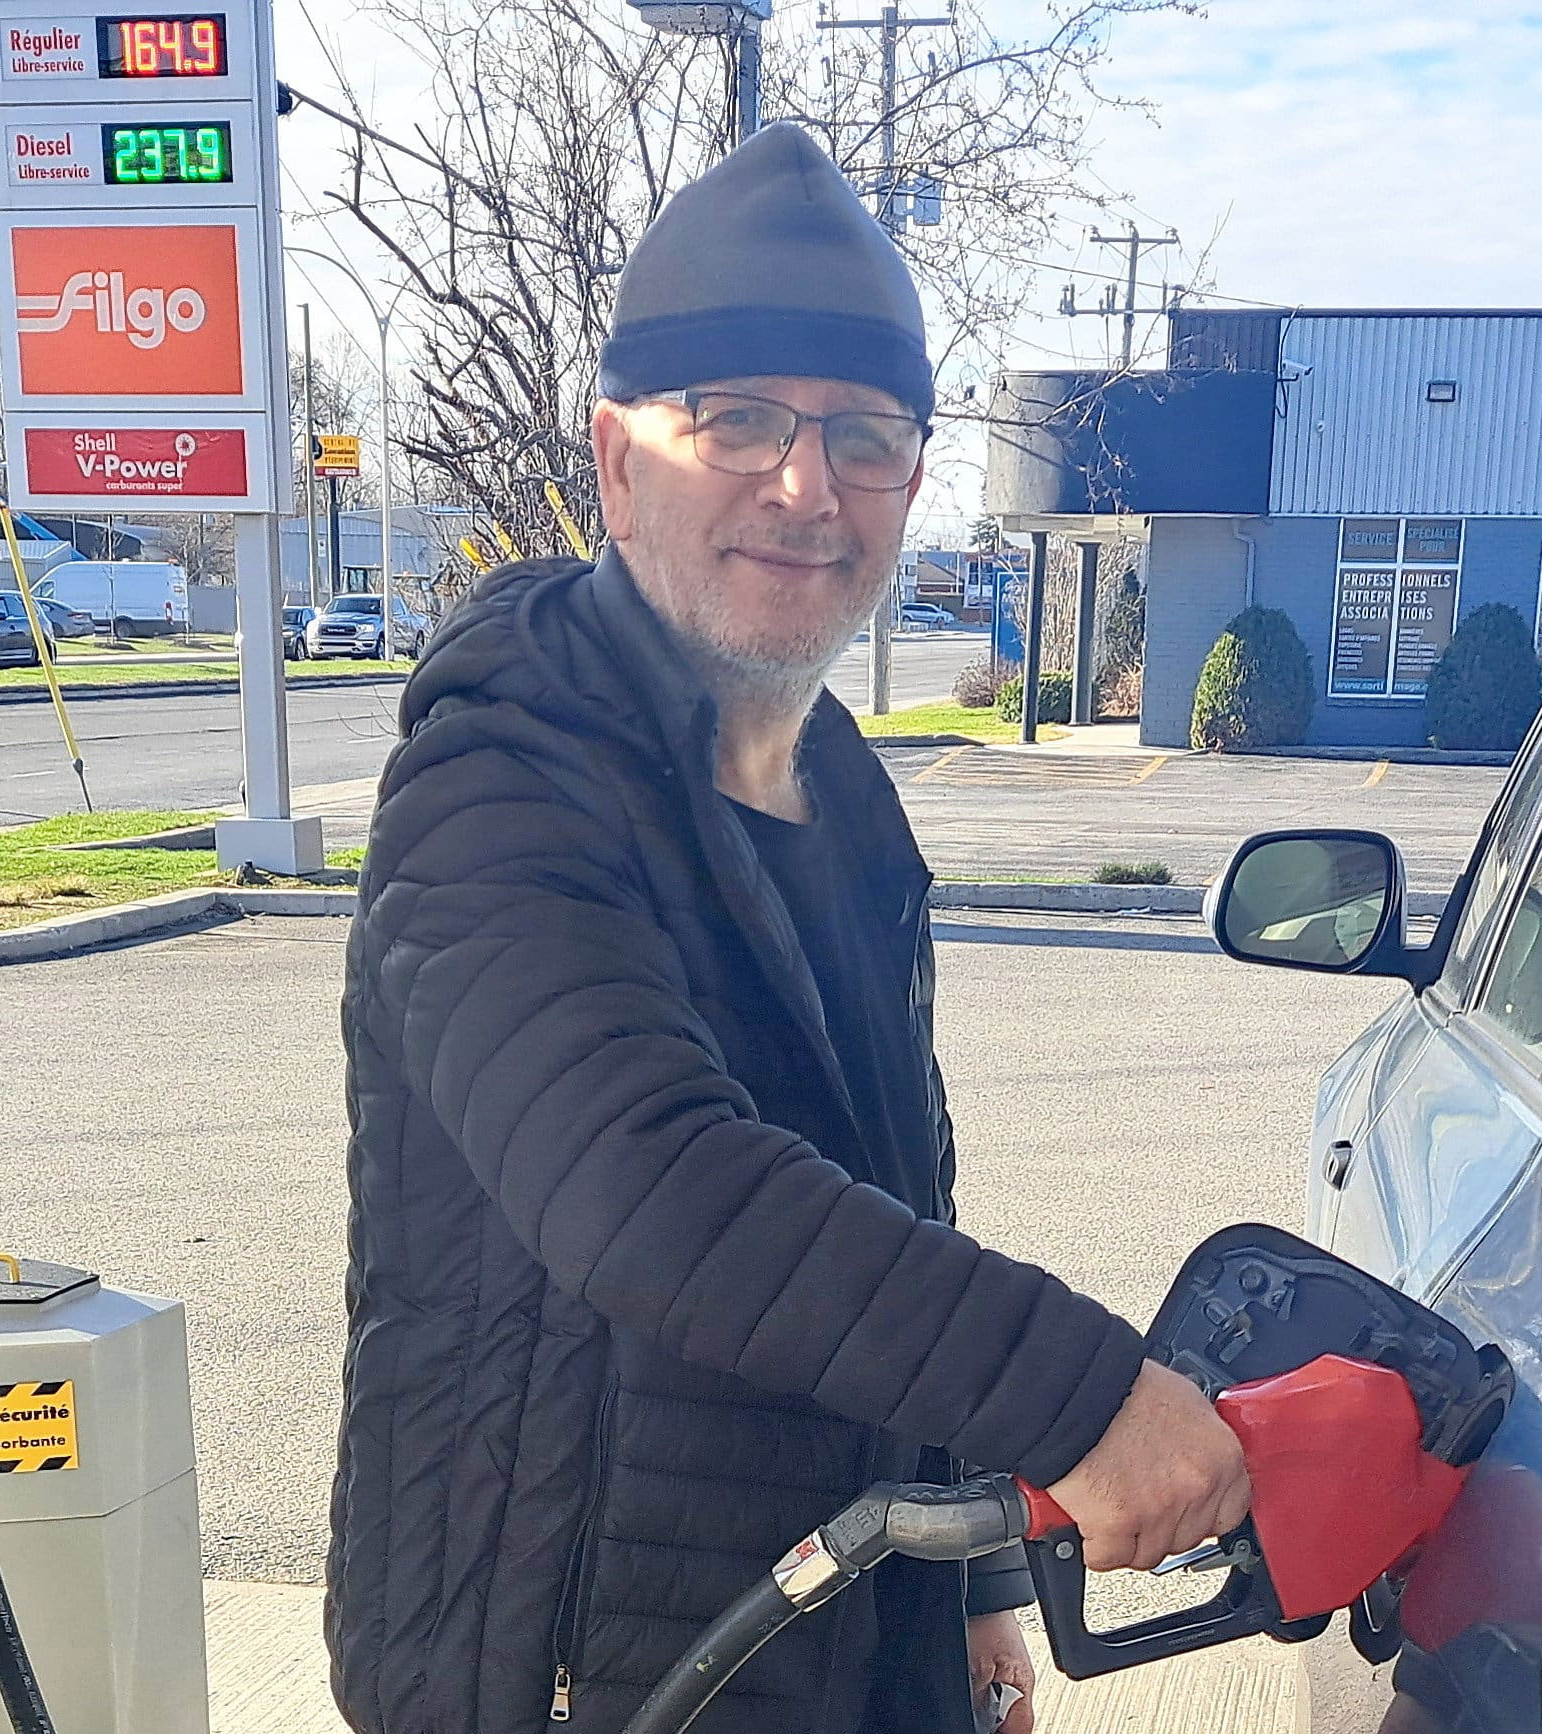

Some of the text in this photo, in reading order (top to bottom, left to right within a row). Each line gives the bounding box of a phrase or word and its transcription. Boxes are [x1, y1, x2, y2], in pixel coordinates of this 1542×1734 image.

[10, 20, 218, 73] Régulier 164.9
[12, 57, 84, 74] Libre-service
[16, 133, 71, 158] Diesel
[18, 162, 90, 180] Libre-service
[16, 270, 206, 350] filgo
[75, 433, 116, 452] Shell
[75, 454, 188, 480] V-Power
[106, 480, 183, 494] carburants super
[1347, 531, 1395, 547] SERVICE
